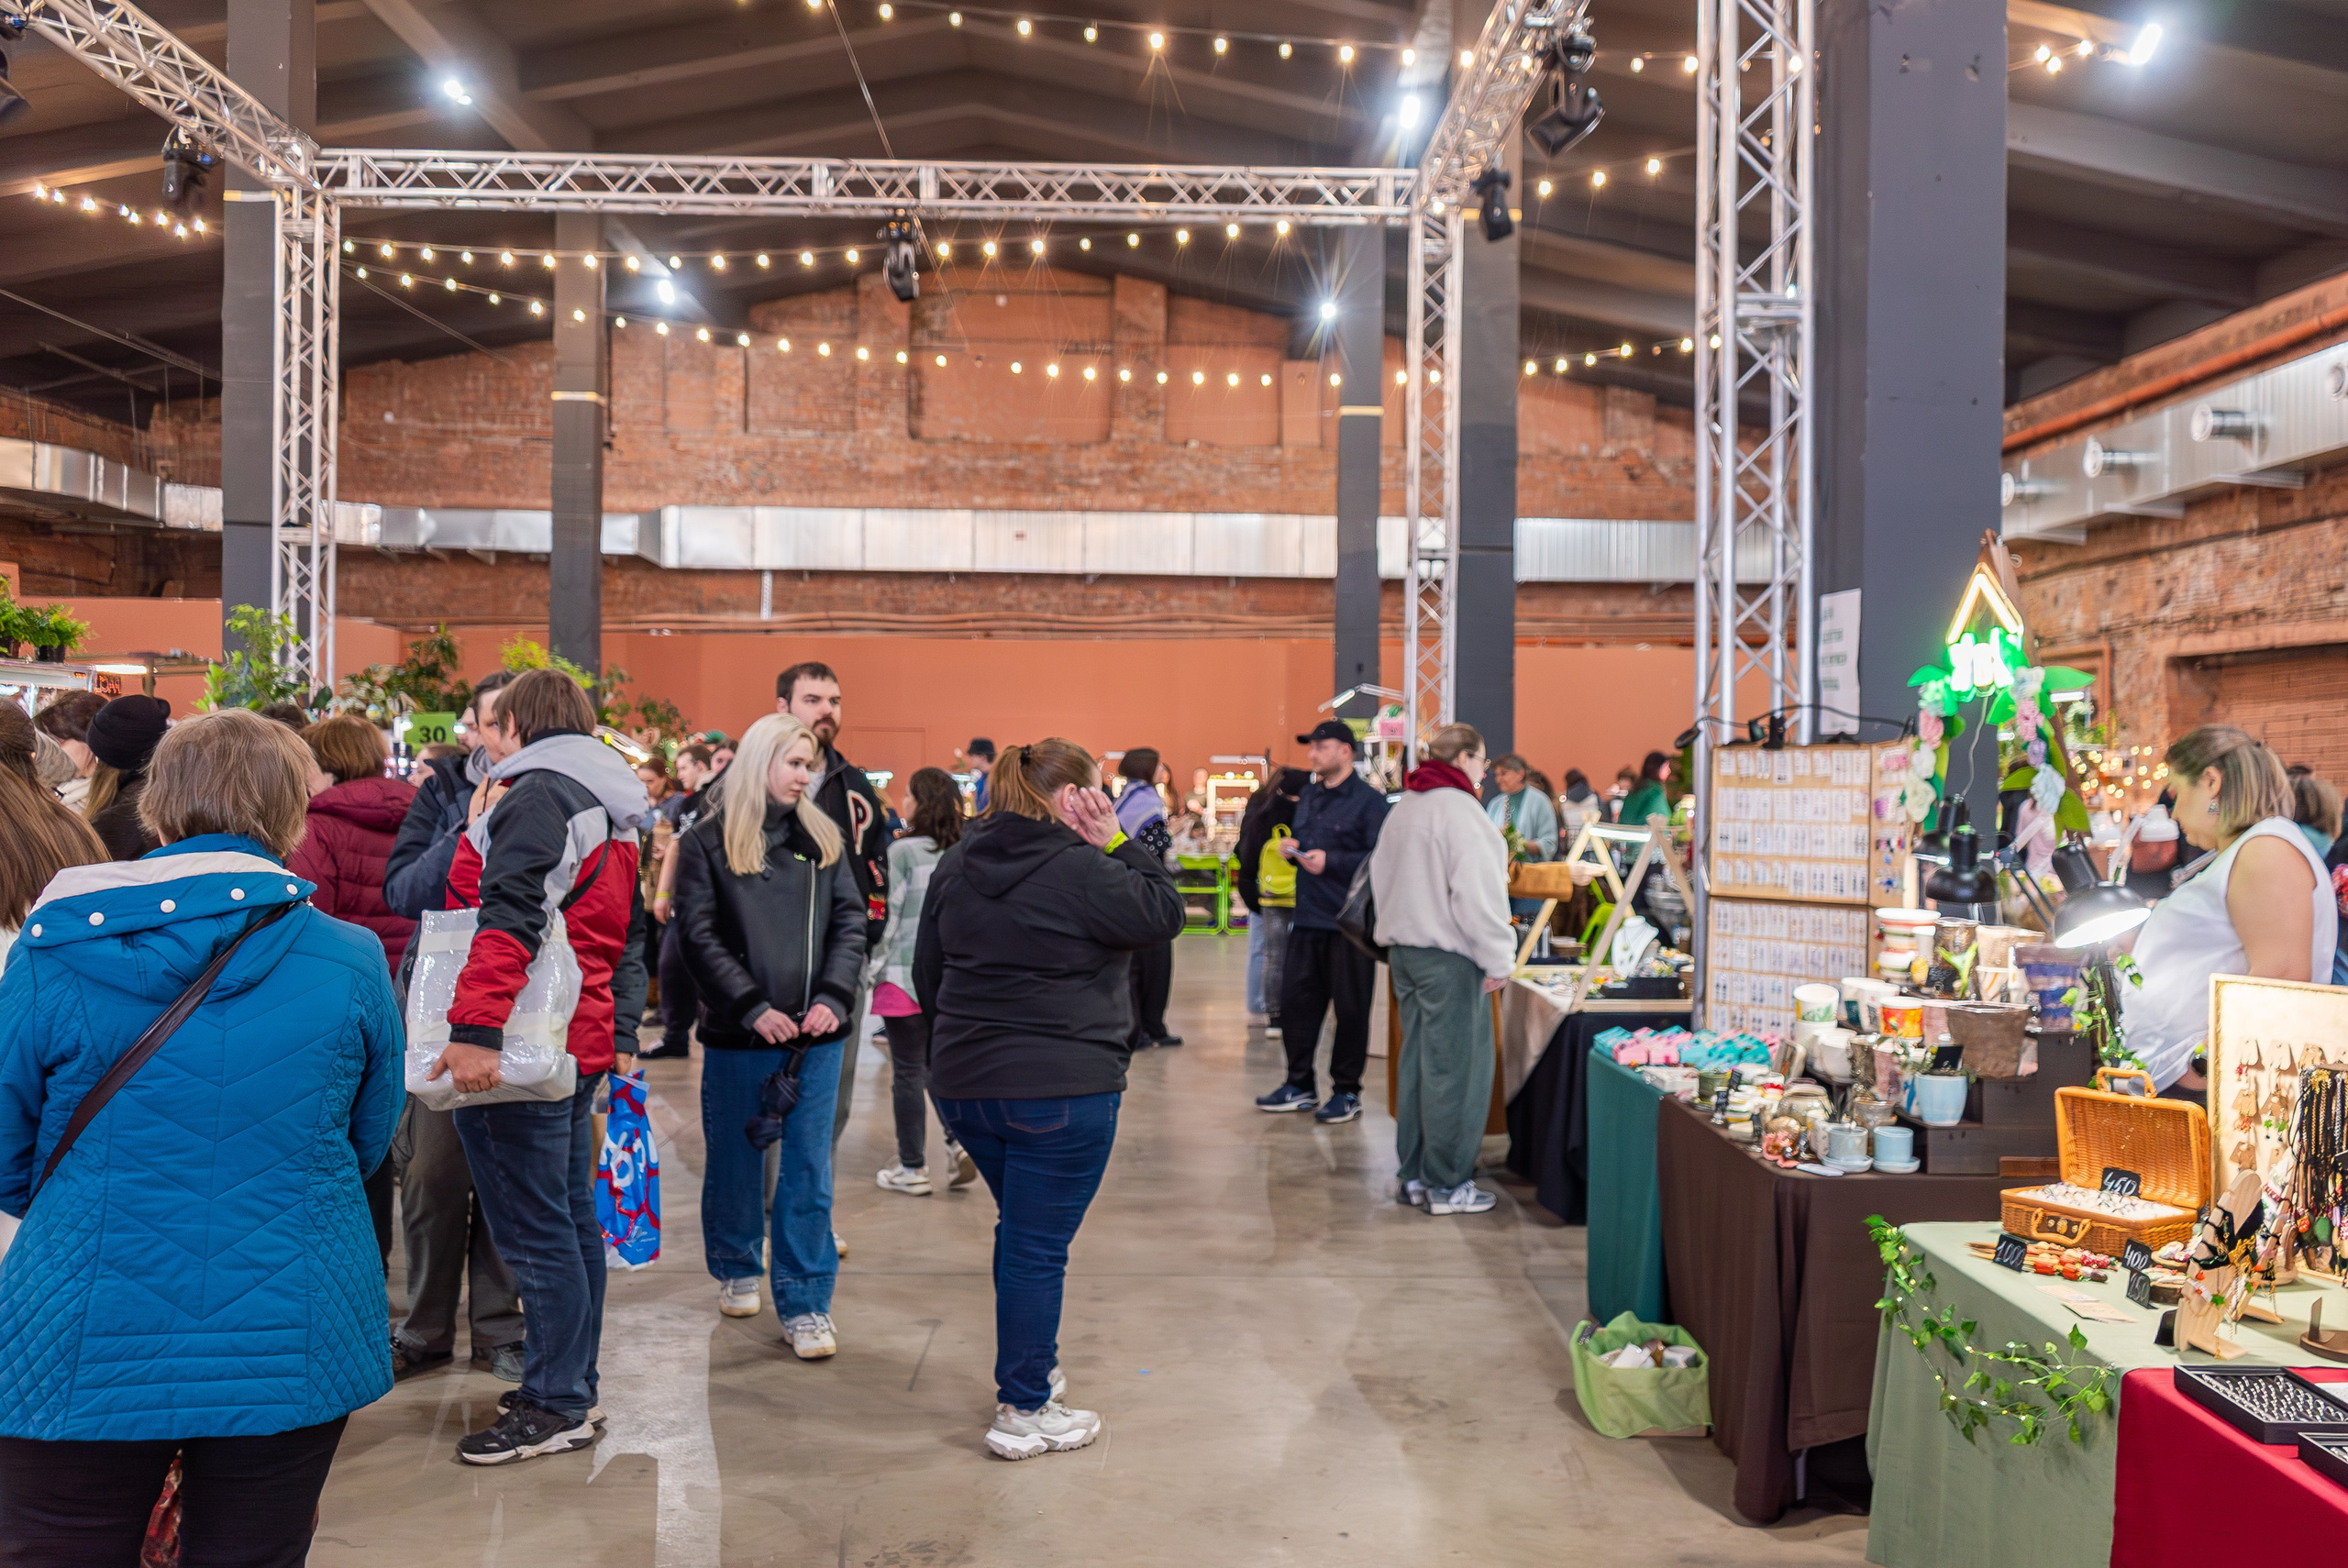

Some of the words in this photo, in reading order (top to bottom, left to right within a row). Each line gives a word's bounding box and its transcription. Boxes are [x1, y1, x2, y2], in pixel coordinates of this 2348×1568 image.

[419, 725, 446, 744] 30
[846, 790, 874, 856] P
[2103, 1171, 2137, 1196] 450
[2124, 1244, 2149, 1270] 400
